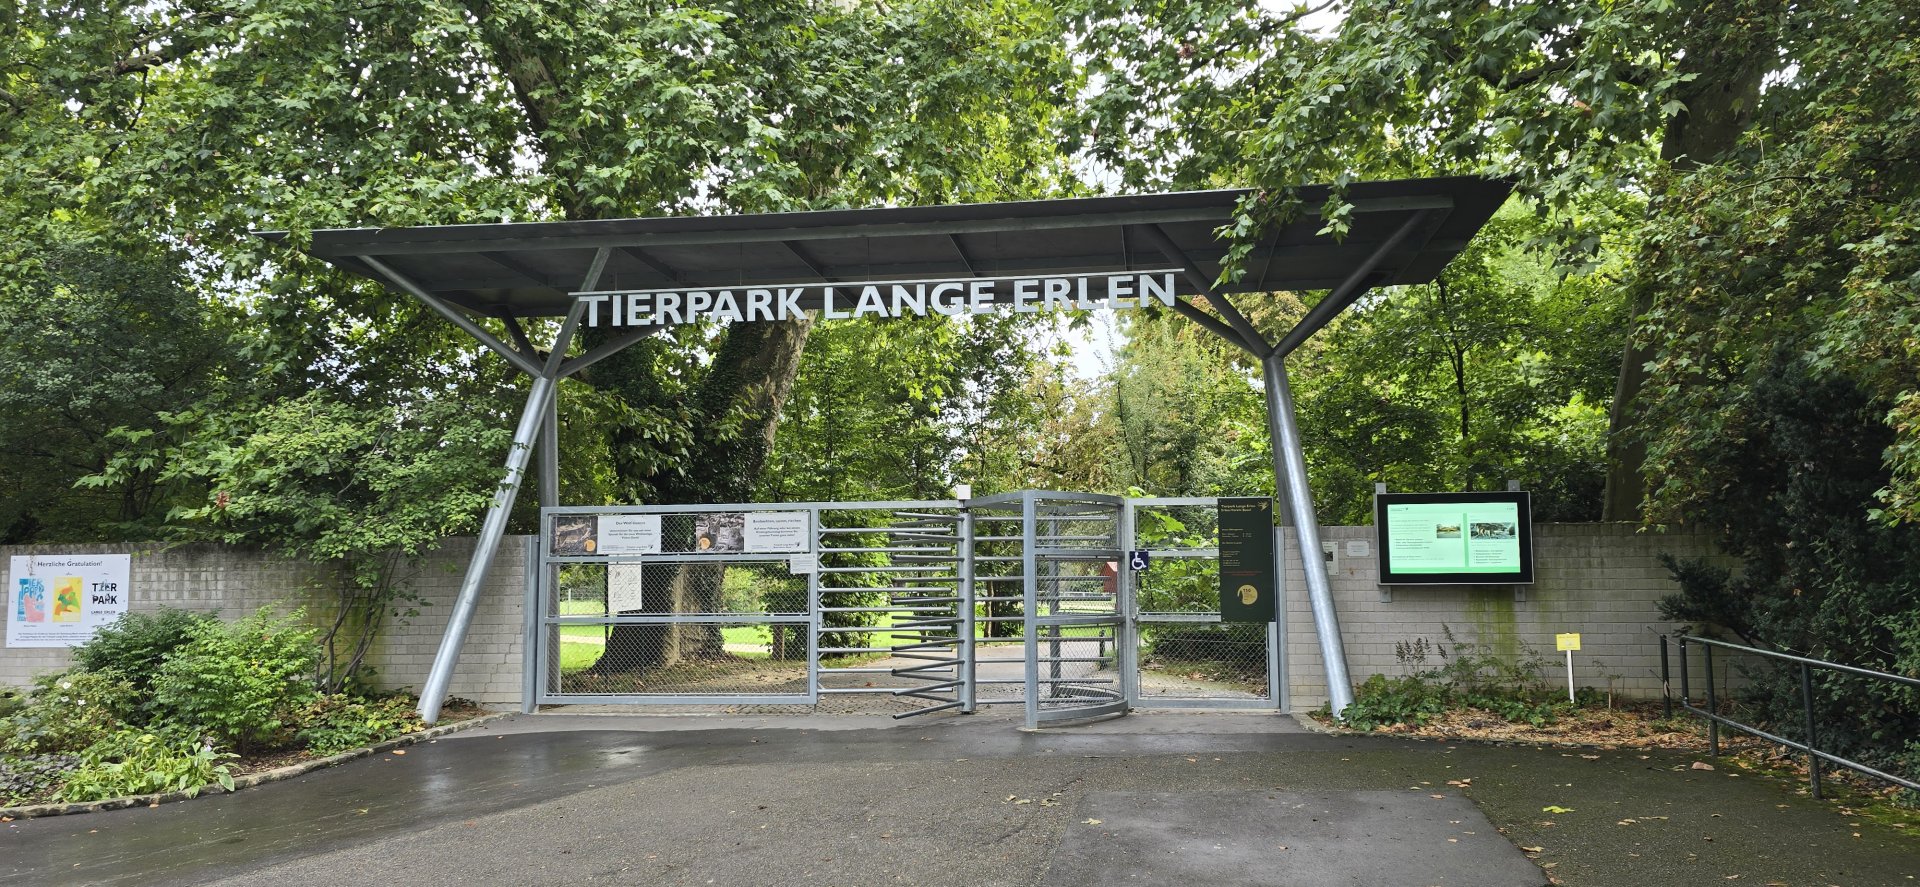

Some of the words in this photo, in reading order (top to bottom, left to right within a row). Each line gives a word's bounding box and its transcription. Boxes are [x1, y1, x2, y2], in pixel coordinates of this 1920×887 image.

[578, 287, 809, 328] TIERPARK
[824, 281, 995, 319] LANGE
[1014, 273, 1176, 312] ERLEN
[92, 594, 117, 604] PARK
